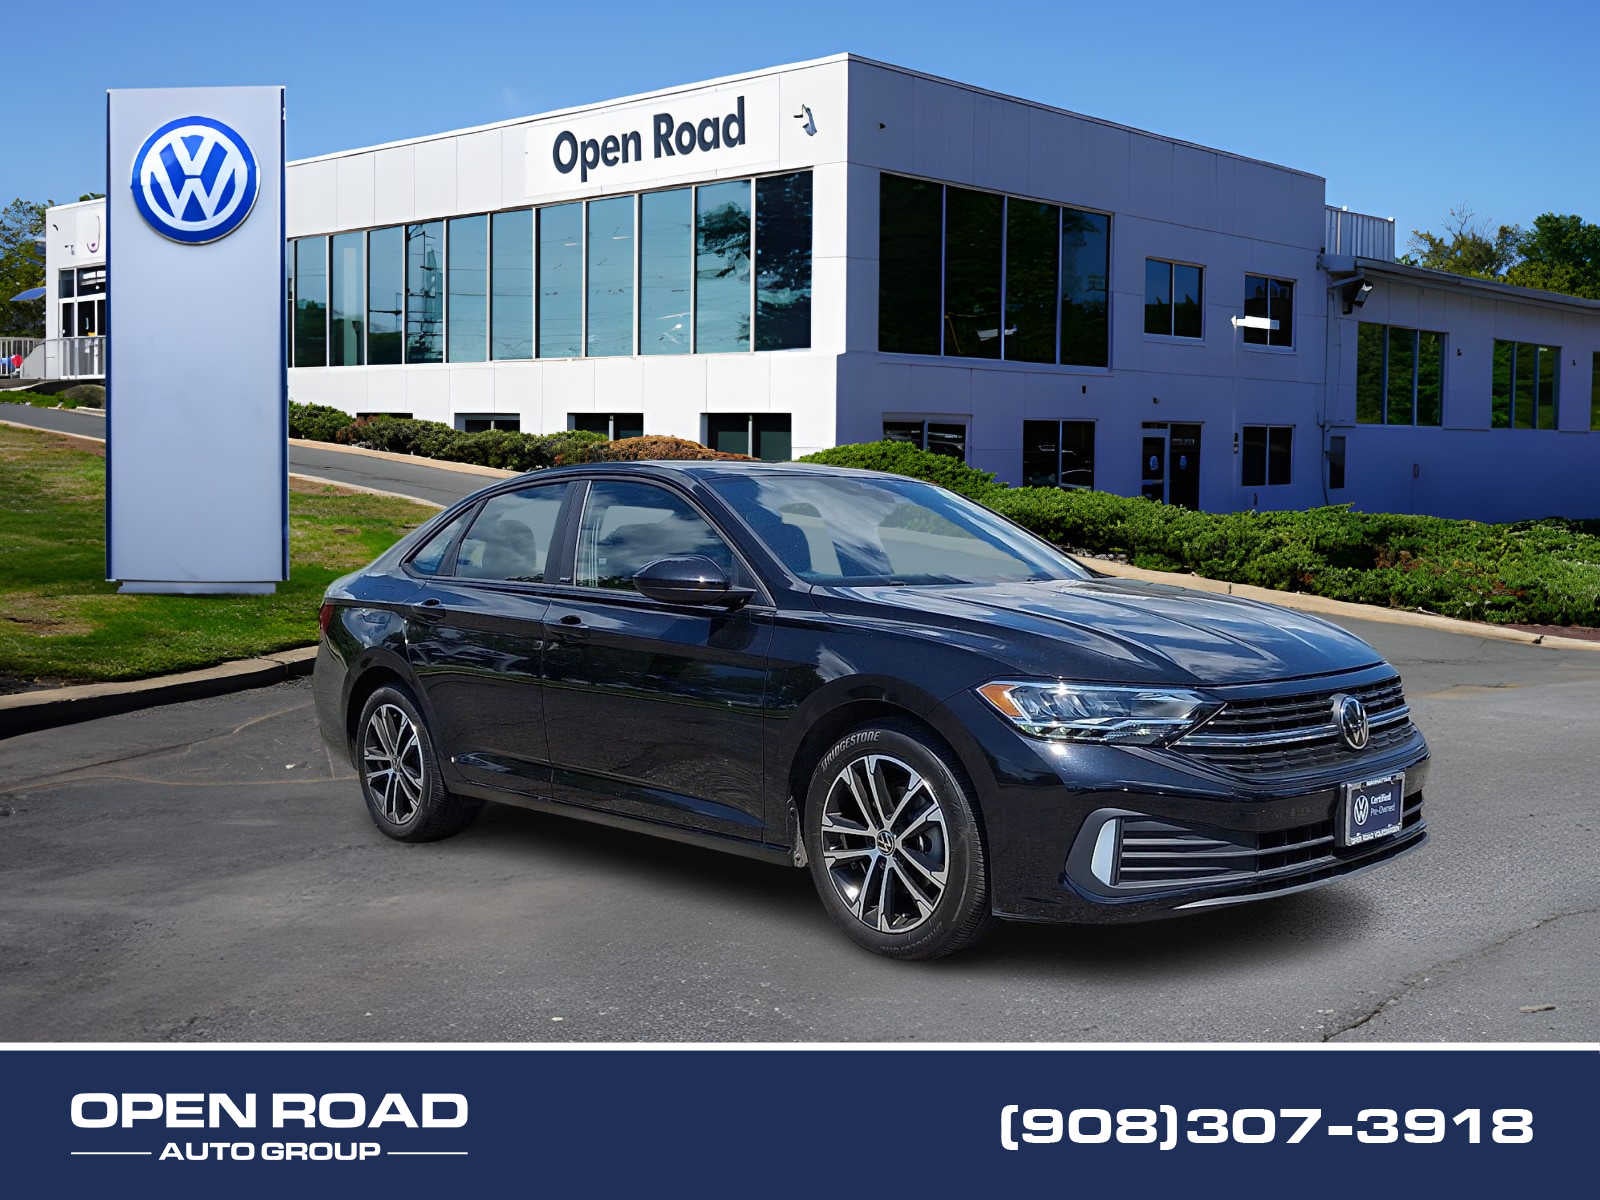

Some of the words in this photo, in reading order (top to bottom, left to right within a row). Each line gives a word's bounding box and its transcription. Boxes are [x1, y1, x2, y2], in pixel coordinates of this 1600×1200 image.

[553, 130, 642, 183] Open
[653, 95, 746, 159] Road
[1370, 792, 1392, 805] Certified
[1370, 803, 1396, 817] Pre-Owned
